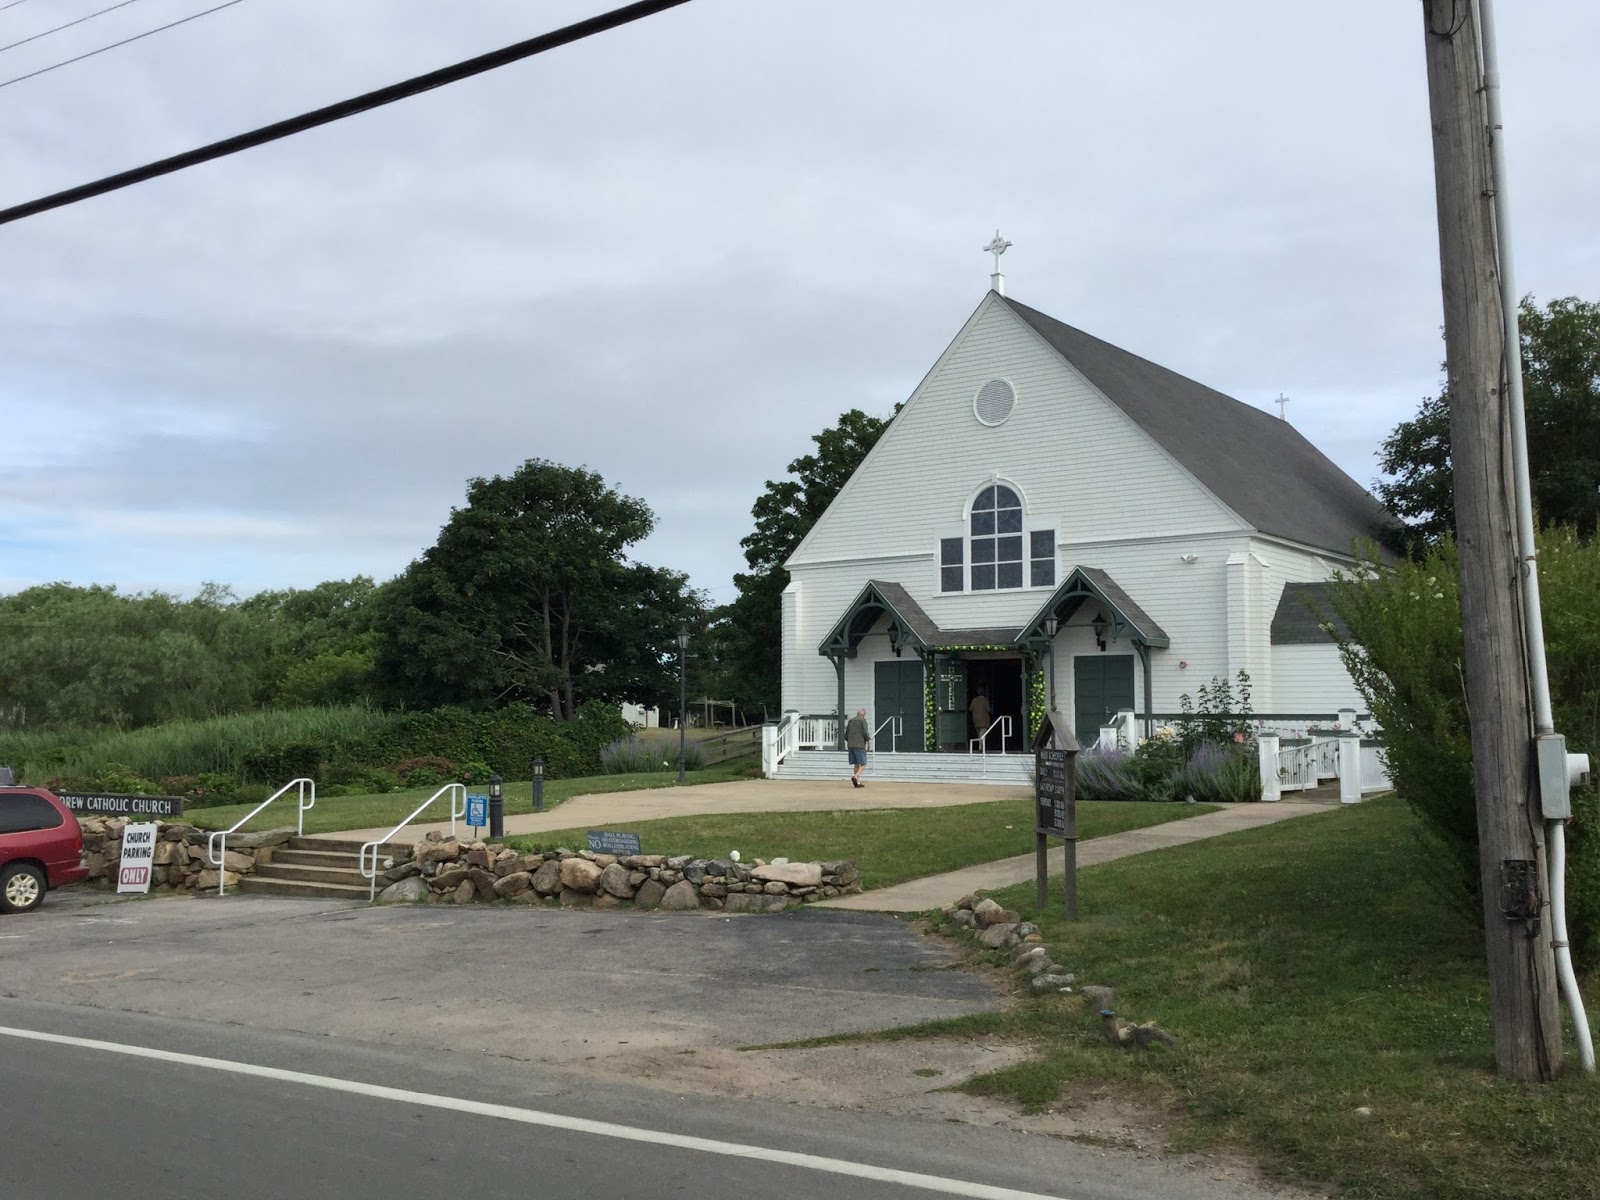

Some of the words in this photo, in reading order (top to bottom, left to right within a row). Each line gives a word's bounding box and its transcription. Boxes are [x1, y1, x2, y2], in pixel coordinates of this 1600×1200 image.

[58, 796, 84, 809] DREW
[87, 797, 129, 812] CATHOLIC
[132, 799, 171, 814] CHURCH
[126, 832, 151, 844] CHURCH
[588, 839, 601, 849] NO
[123, 847, 151, 858] PARKING
[122, 868, 147, 884] ONLY
